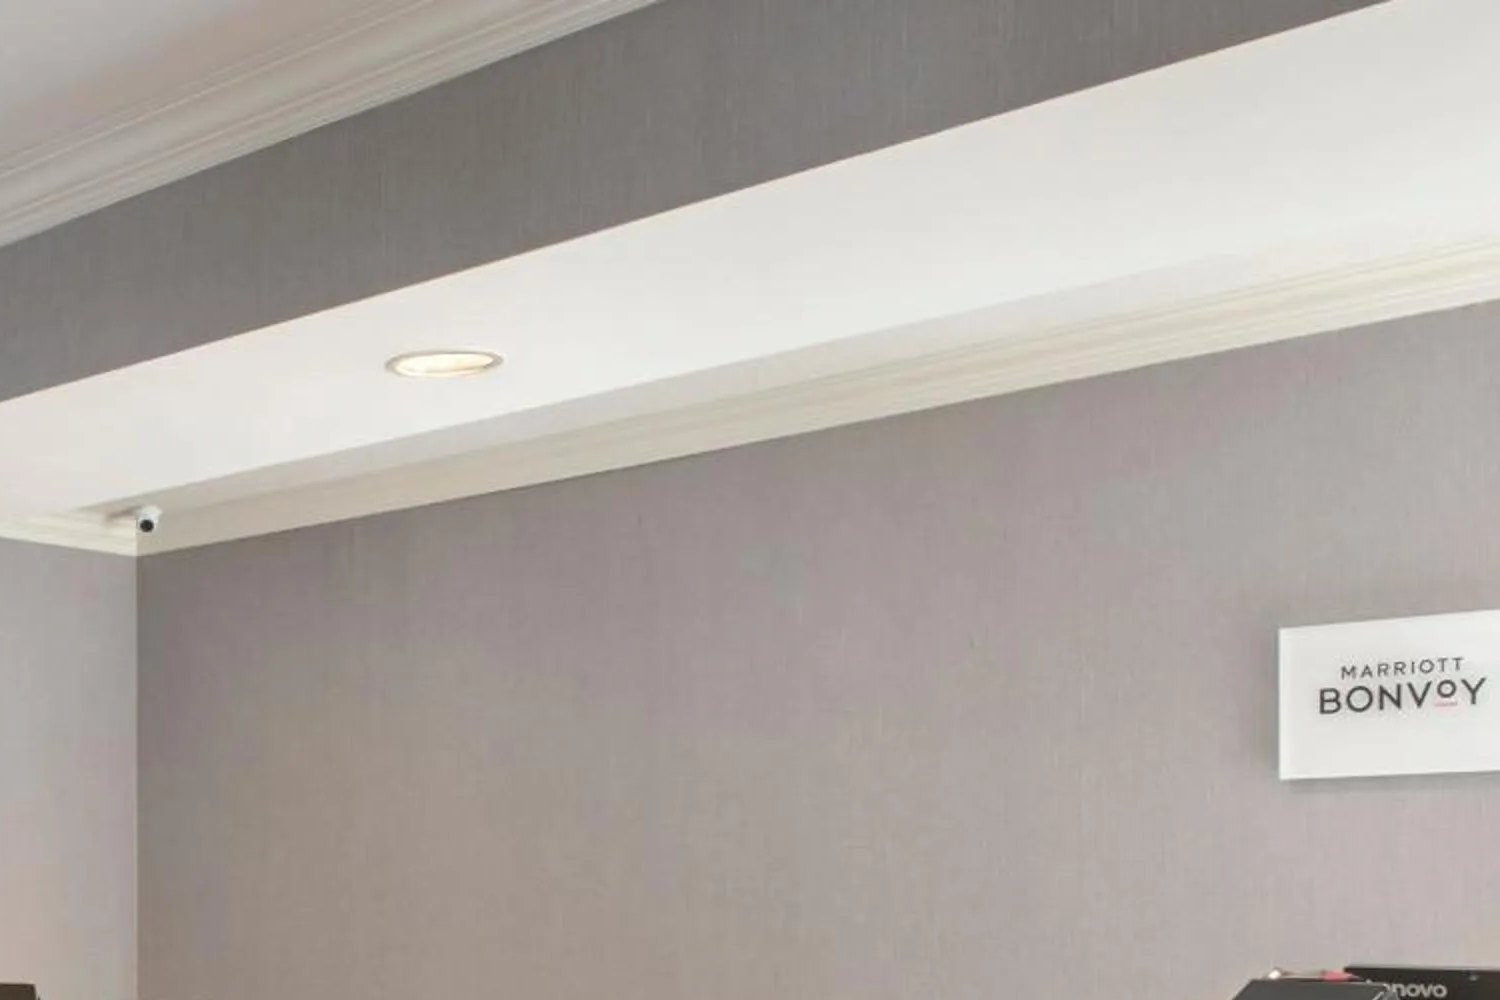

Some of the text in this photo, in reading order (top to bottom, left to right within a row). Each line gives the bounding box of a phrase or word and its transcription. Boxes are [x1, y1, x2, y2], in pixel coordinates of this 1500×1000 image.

[1341, 656, 1465, 680] MARRIOTT
[1319, 677, 1487, 715] BONVOY
[1383, 983, 1448, 999] novo
